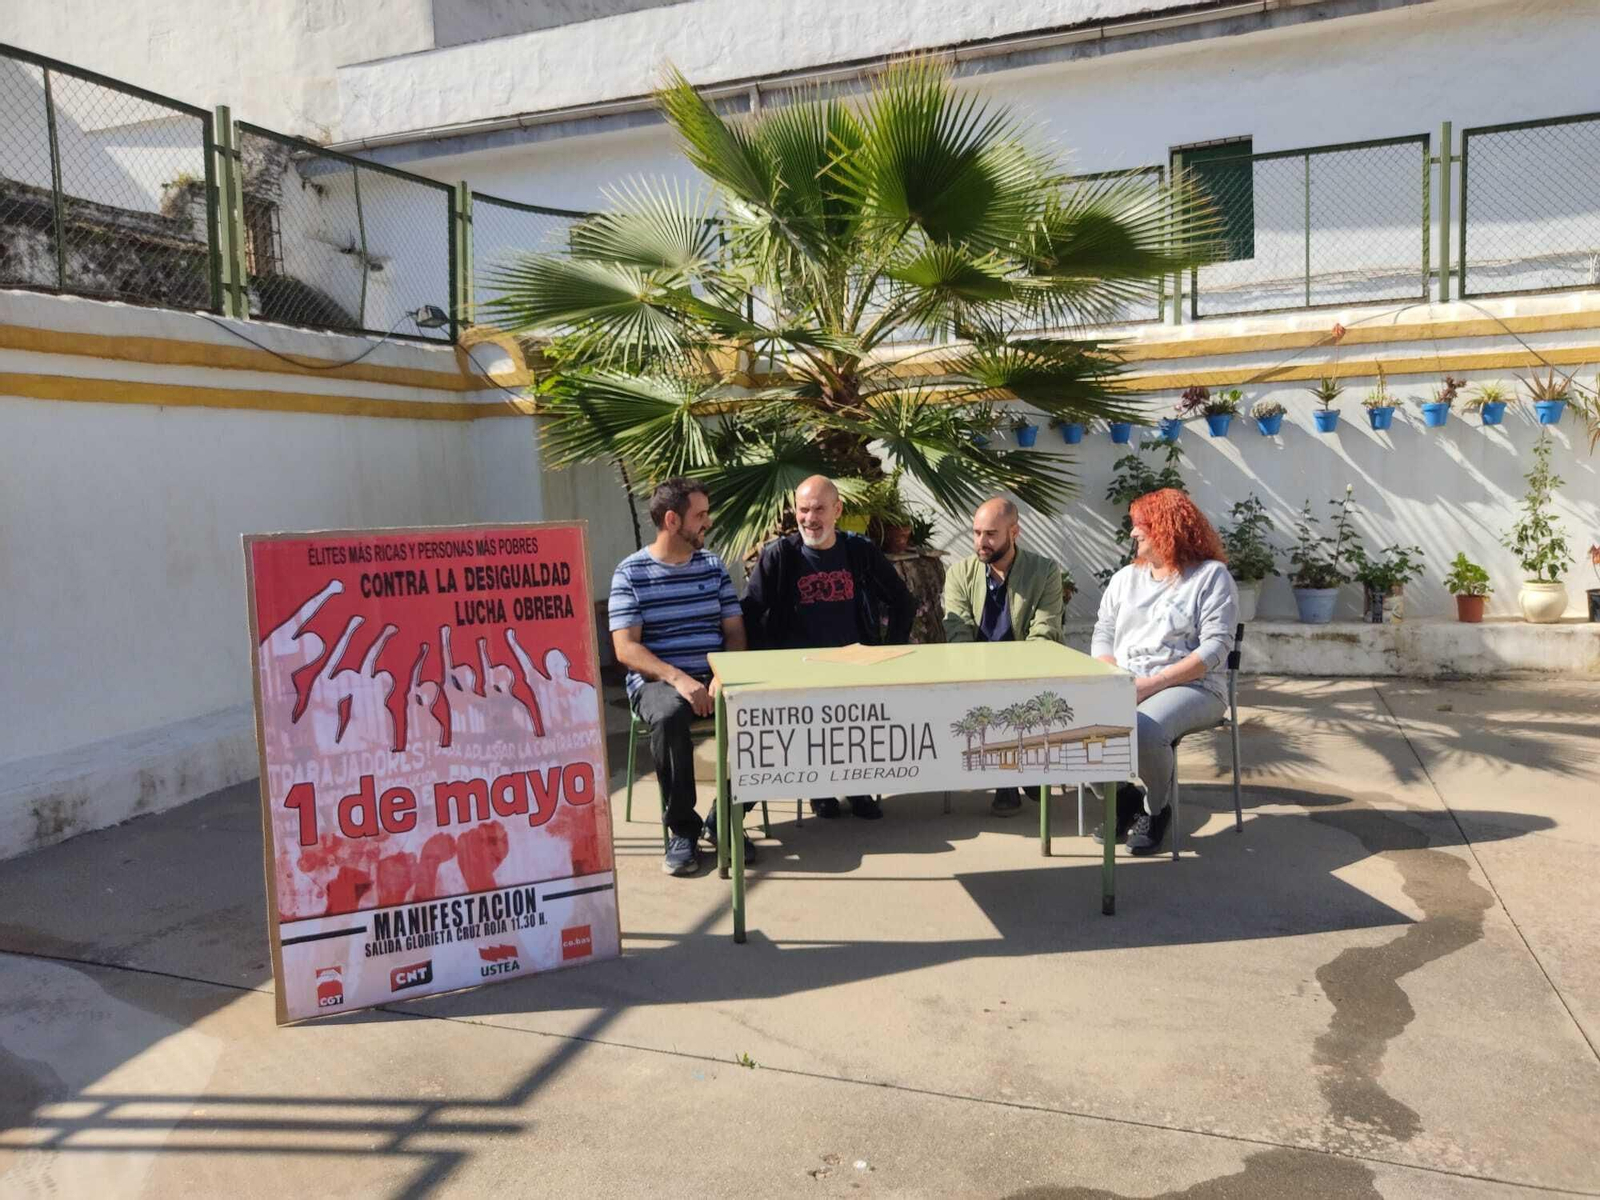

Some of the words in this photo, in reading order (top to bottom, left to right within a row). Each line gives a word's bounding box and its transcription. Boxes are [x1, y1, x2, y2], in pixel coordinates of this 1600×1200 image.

[308, 544, 346, 566] ÉLITES
[348, 541, 372, 563] MÁS
[374, 544, 408, 562] RICAS
[408, 543, 416, 559] Y
[418, 540, 474, 559] PERSONAS
[476, 536, 496, 556] MÁS
[499, 537, 539, 555] POBRES
[361, 569, 429, 598] CONTRA
[436, 567, 458, 593] LA
[464, 561, 571, 592] DESIGUALDAD
[455, 598, 507, 626] LUCHA
[513, 594, 574, 621] OBRERA
[736, 706, 814, 727] CENTRO
[821, 703, 891, 724] SOCIAL
[737, 728, 796, 770] REY
[807, 722, 938, 766] HEREDIA
[738, 770, 819, 787] ESPACIO
[830, 765, 920, 782] LIBERADO
[283, 781, 318, 846] 1
[338, 775, 417, 838] de
[434, 762, 595, 827] mayo
[374, 887, 537, 941] MANIFESTACION
[365, 938, 402, 957] SALIDA
[406, 929, 453, 950] GLORIETA
[456, 923, 481, 941] CRUZ
[484, 919, 507, 936] ROJA
[511, 913, 536, 931] 11.30
[395, 967, 428, 985] CNT
[481, 960, 520, 977] USTEA
[320, 995, 343, 1006] CGT
